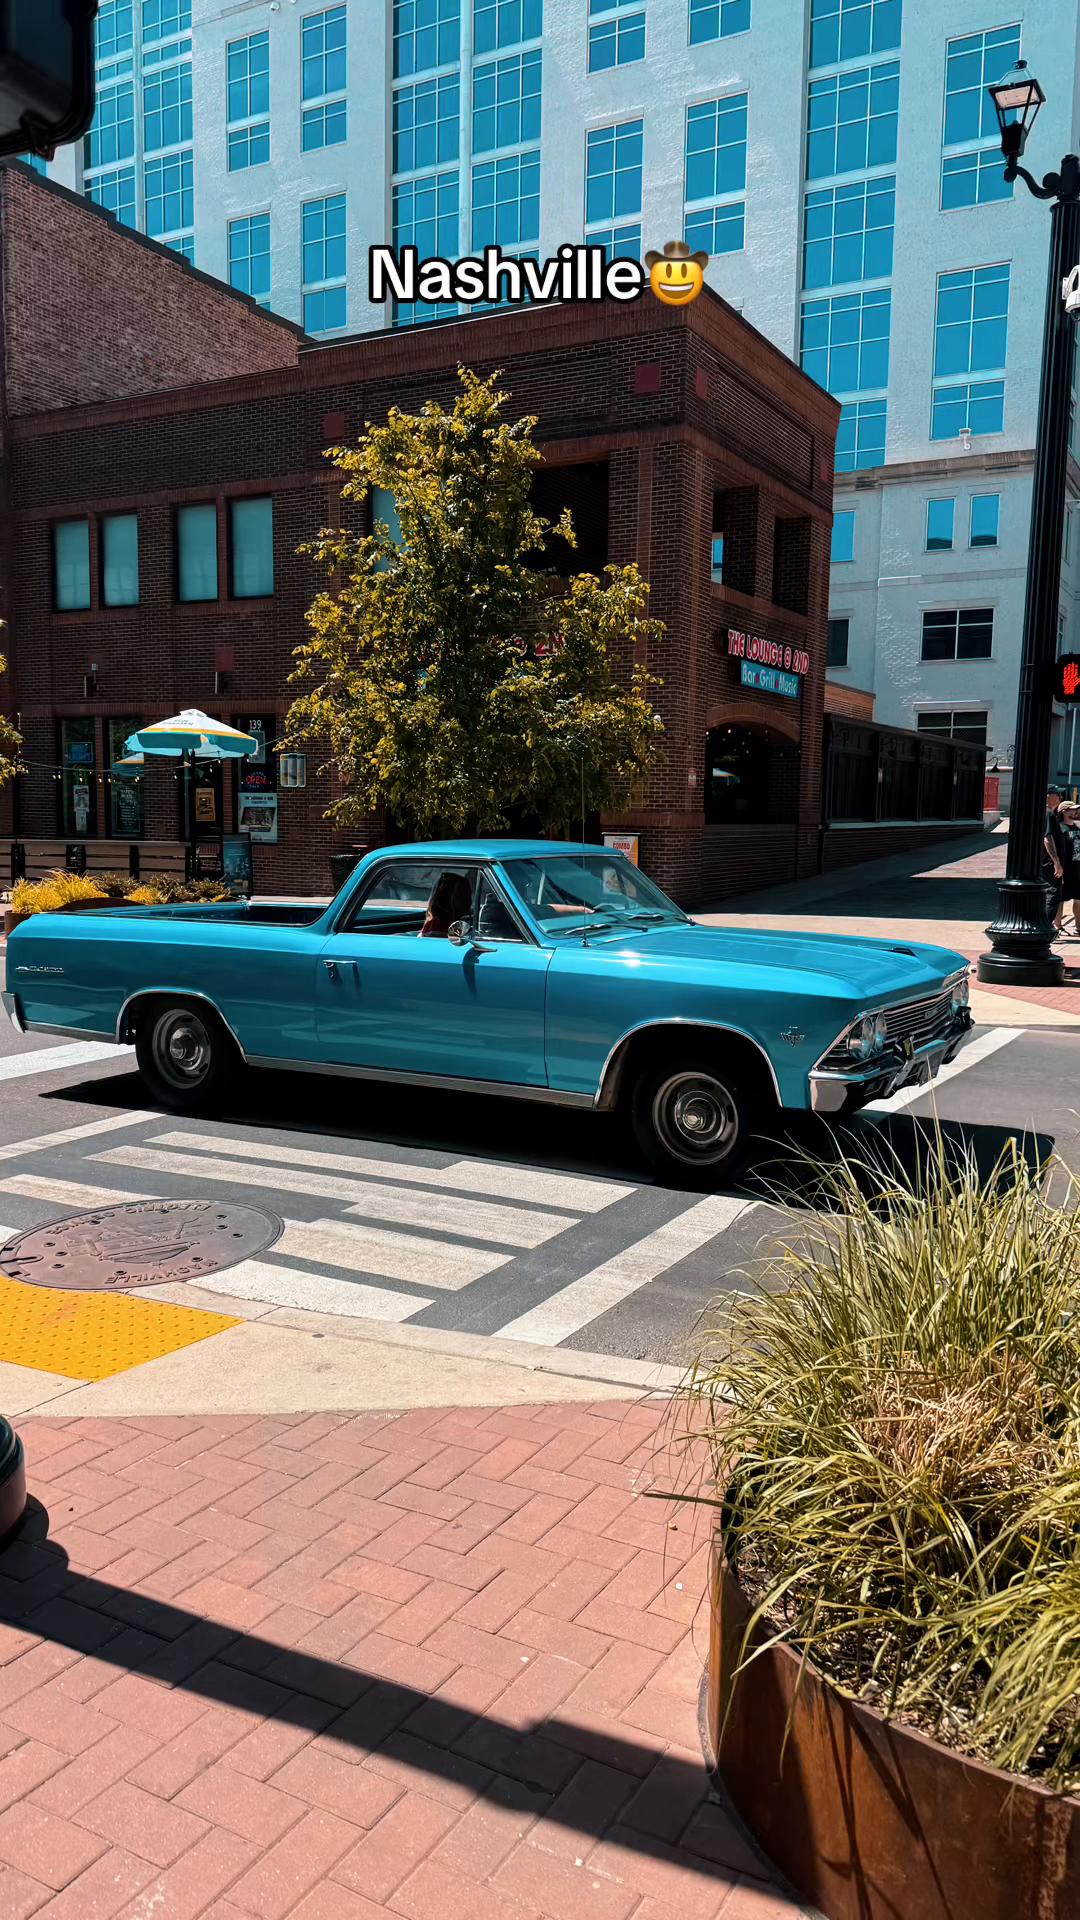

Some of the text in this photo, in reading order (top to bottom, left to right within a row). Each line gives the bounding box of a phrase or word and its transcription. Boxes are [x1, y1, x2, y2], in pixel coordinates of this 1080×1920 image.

[727, 628, 745, 657] THE
[746, 634, 783, 667] LOUNGE
[792, 649, 810, 675] 2ND
[741, 663, 797, 695] Bar Grill Music
[249, 719, 262, 730] 139
[246, 775, 267, 785] OPEN
